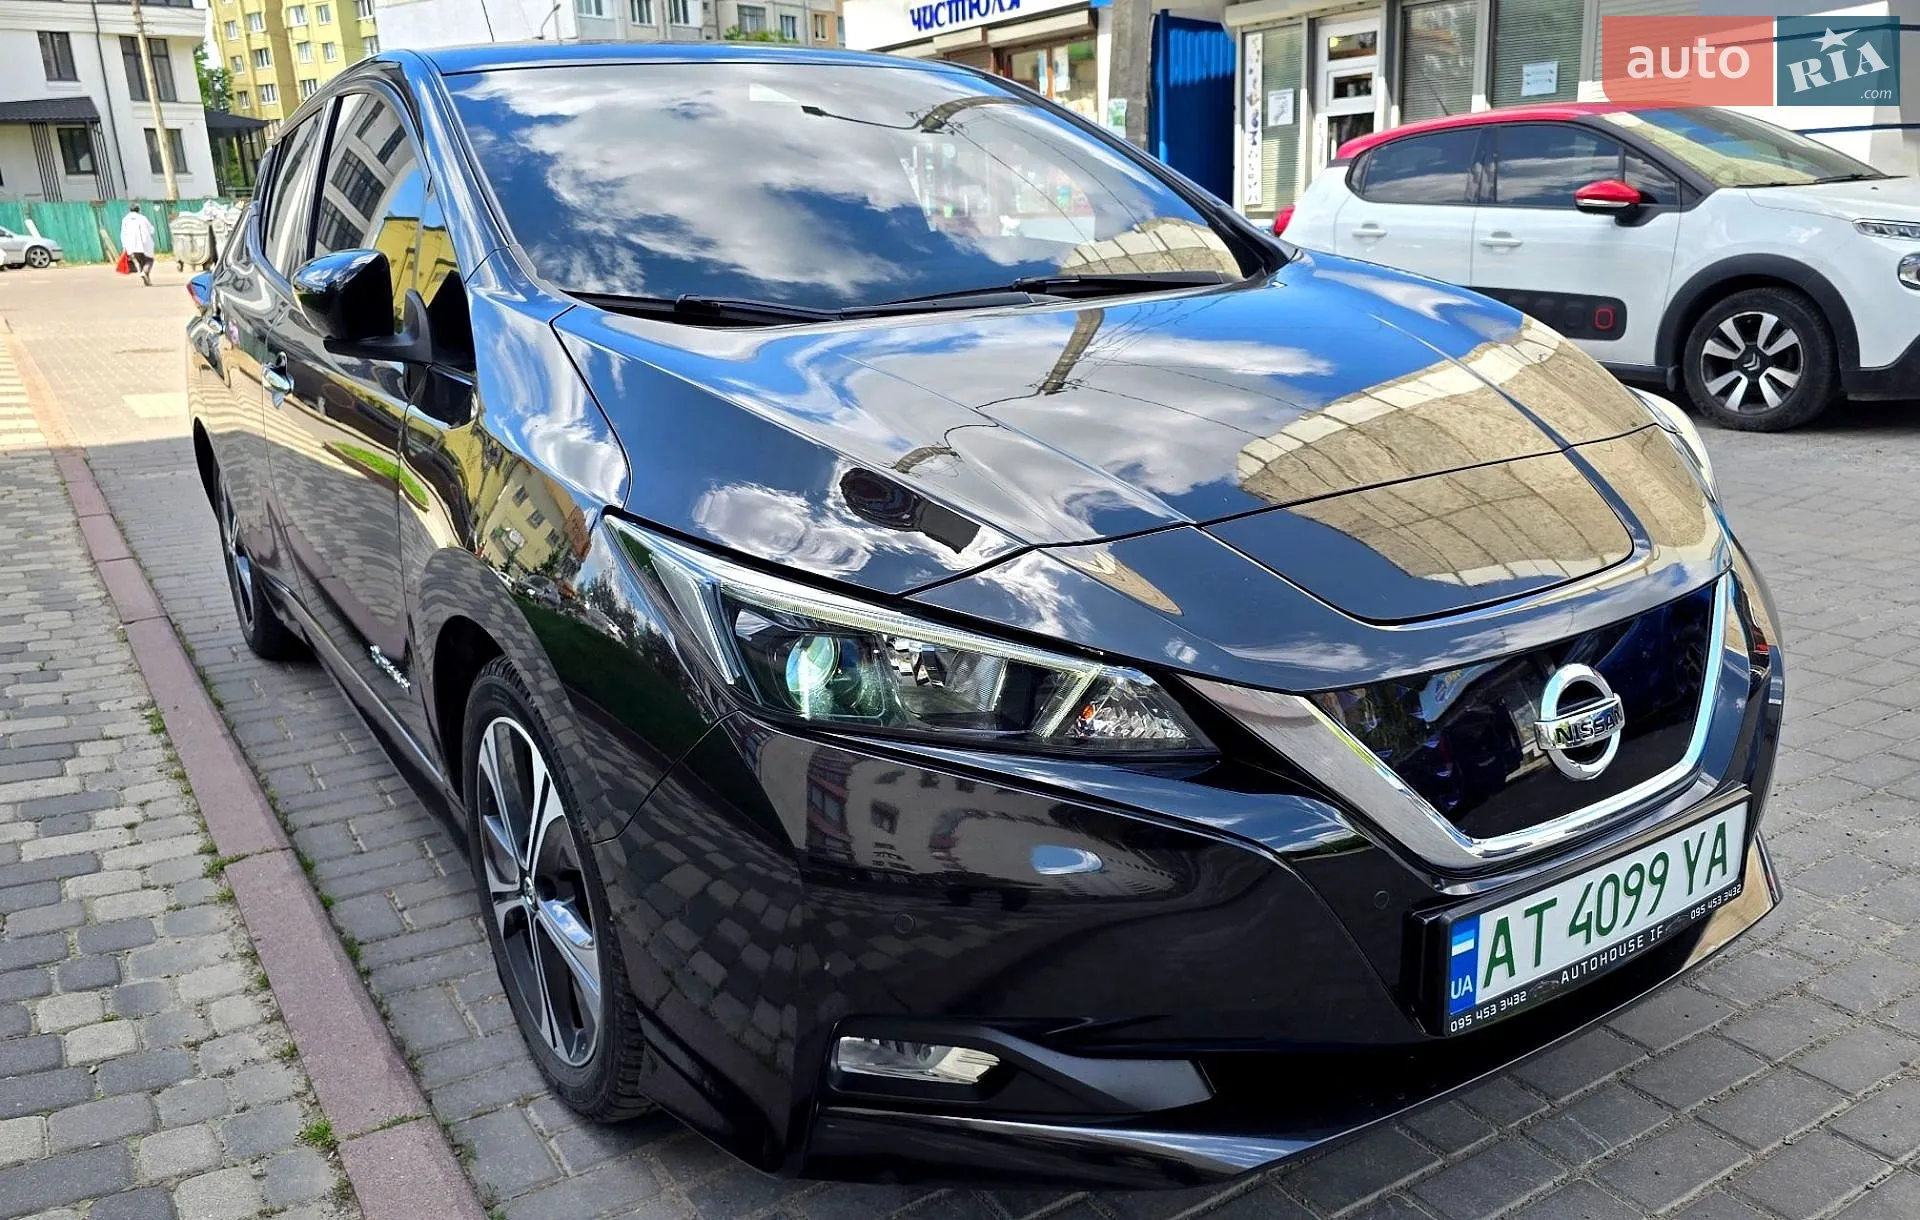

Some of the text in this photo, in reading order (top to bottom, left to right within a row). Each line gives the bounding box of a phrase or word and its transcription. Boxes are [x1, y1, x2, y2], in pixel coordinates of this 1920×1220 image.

[1554, 708, 1620, 746] NISSAN
[1483, 821, 1728, 988] AT 4099 YA
[1690, 883, 1742, 920] 095 453 3432
[1560, 925, 1664, 984] AUTOHOUSE IF
[1450, 974, 1473, 999] UA
[1450, 990, 1527, 1032] 095 453 3432
